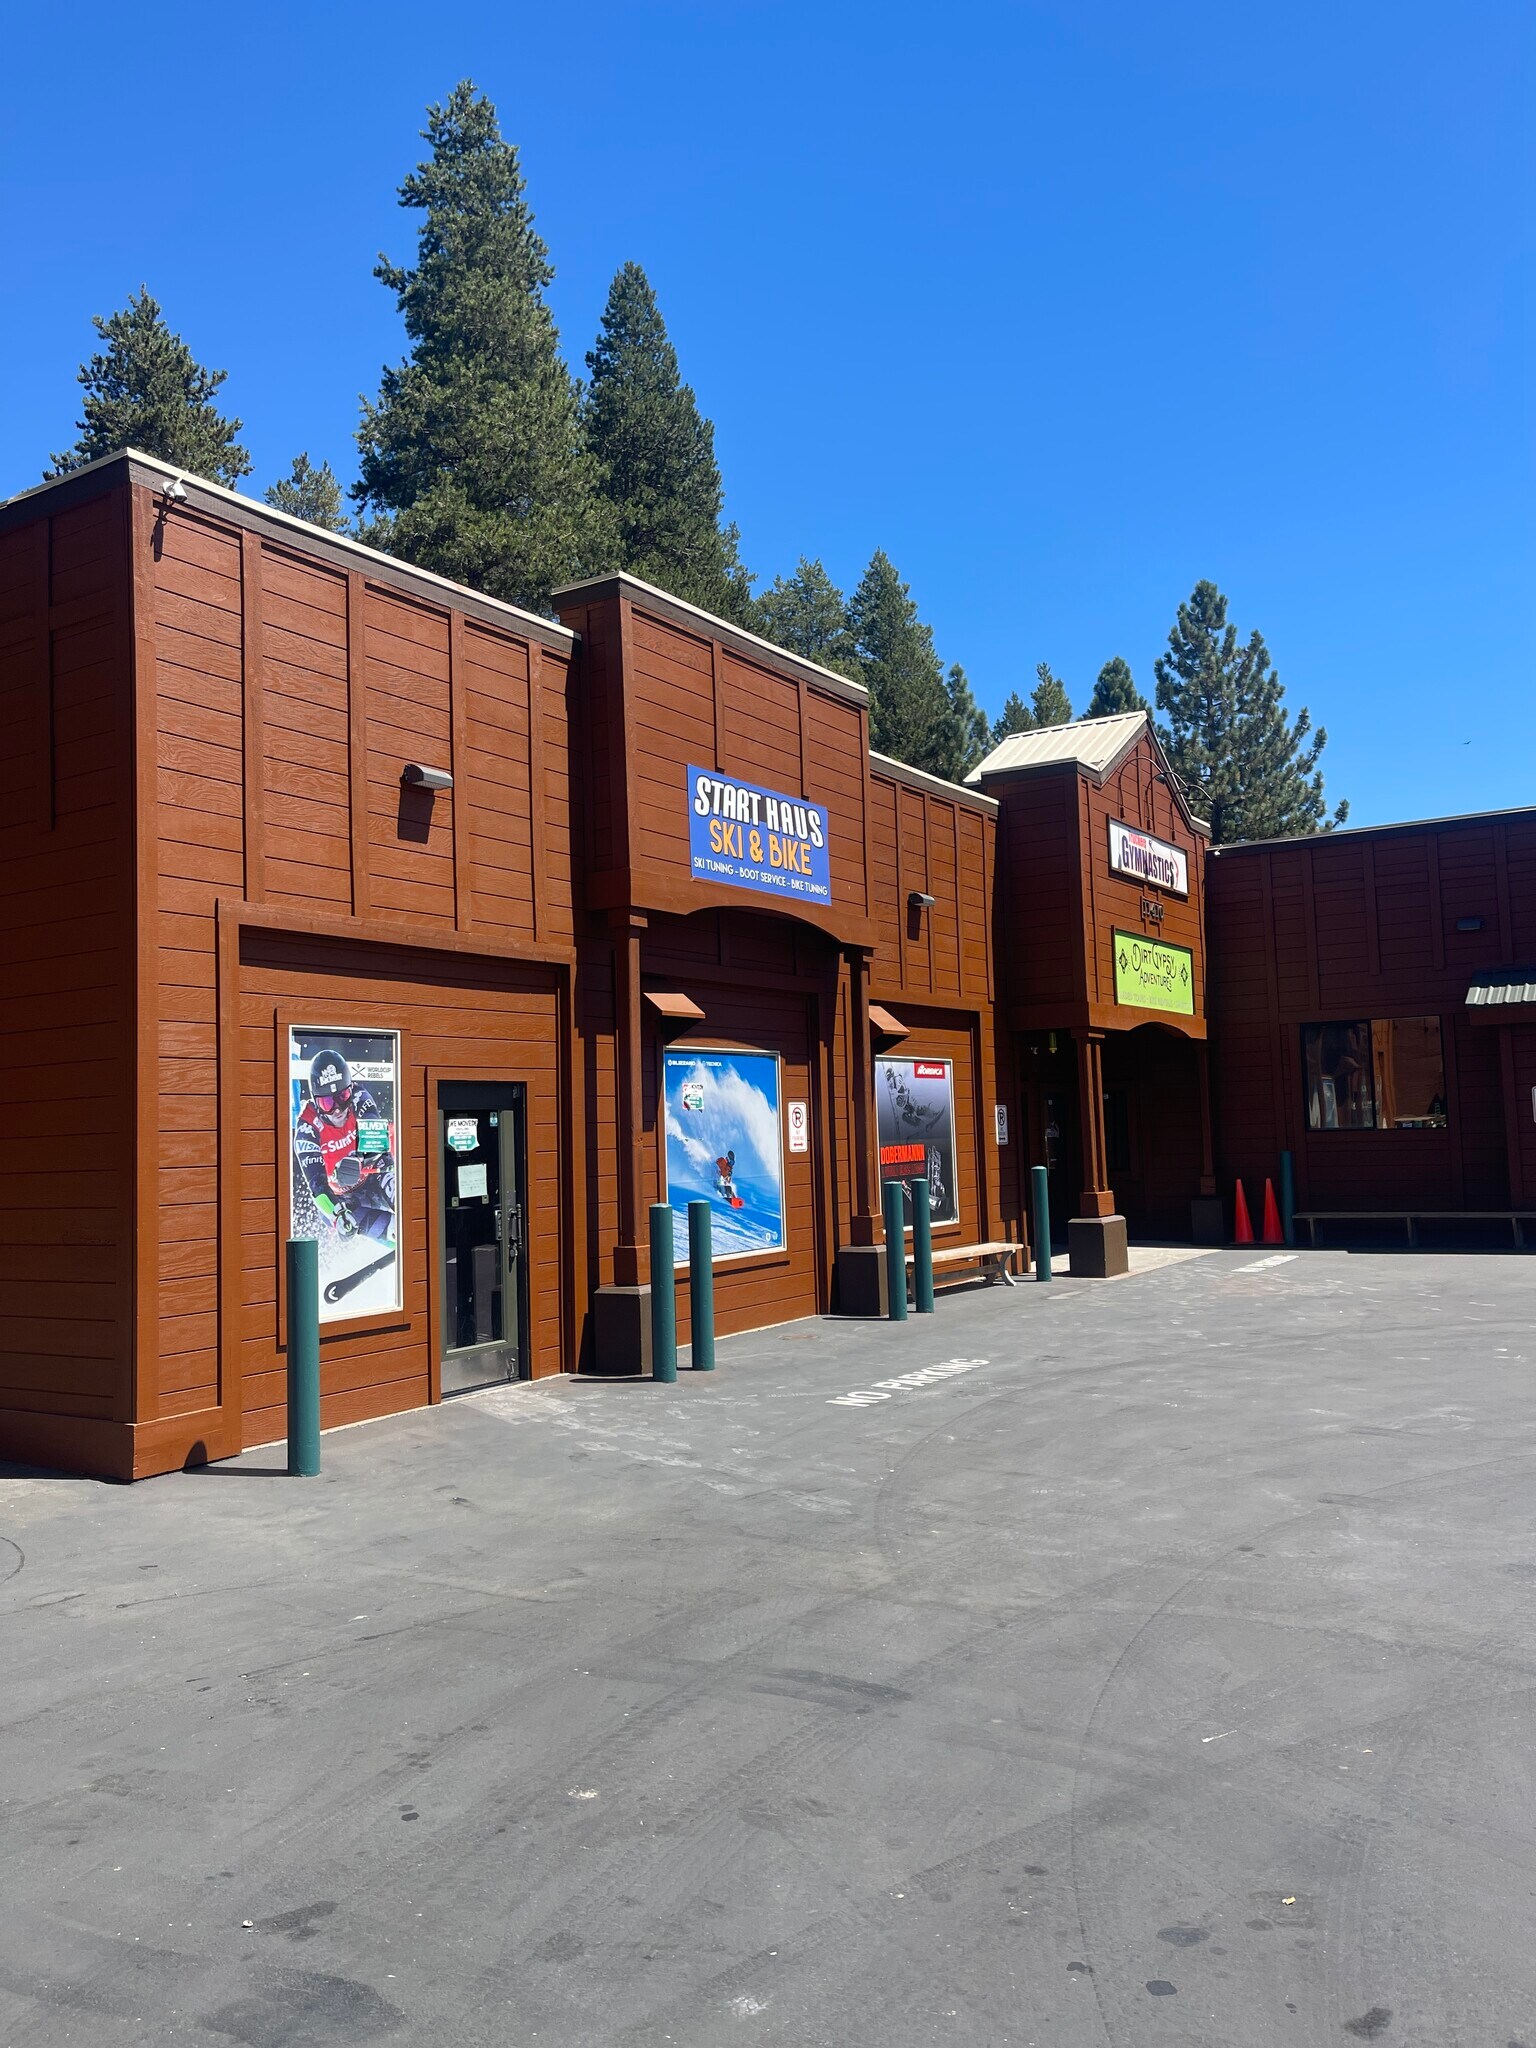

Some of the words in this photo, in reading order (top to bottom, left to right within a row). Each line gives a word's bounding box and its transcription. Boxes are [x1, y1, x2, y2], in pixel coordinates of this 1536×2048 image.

[694, 775, 762, 827] START
[765, 796, 825, 848] HAUS
[709, 818, 744, 860] SKI
[749, 829, 764, 864] &
[769, 834, 813, 876] BIKE
[1121, 835, 1174, 885] GYMNASTICS
[693, 856, 705, 870] SKI
[706, 859, 734, 875] TUNING
[740, 866, 760, 881] BOOT
[760, 873, 787, 887] SERVICE
[791, 879, 805, 892] BIKE
[805, 880, 828, 896] TUNING
[880, 1144, 925, 1165] DOBERMANN
[825, 1391, 892, 1407] NO
[871, 1358, 990, 1391] PARKING
